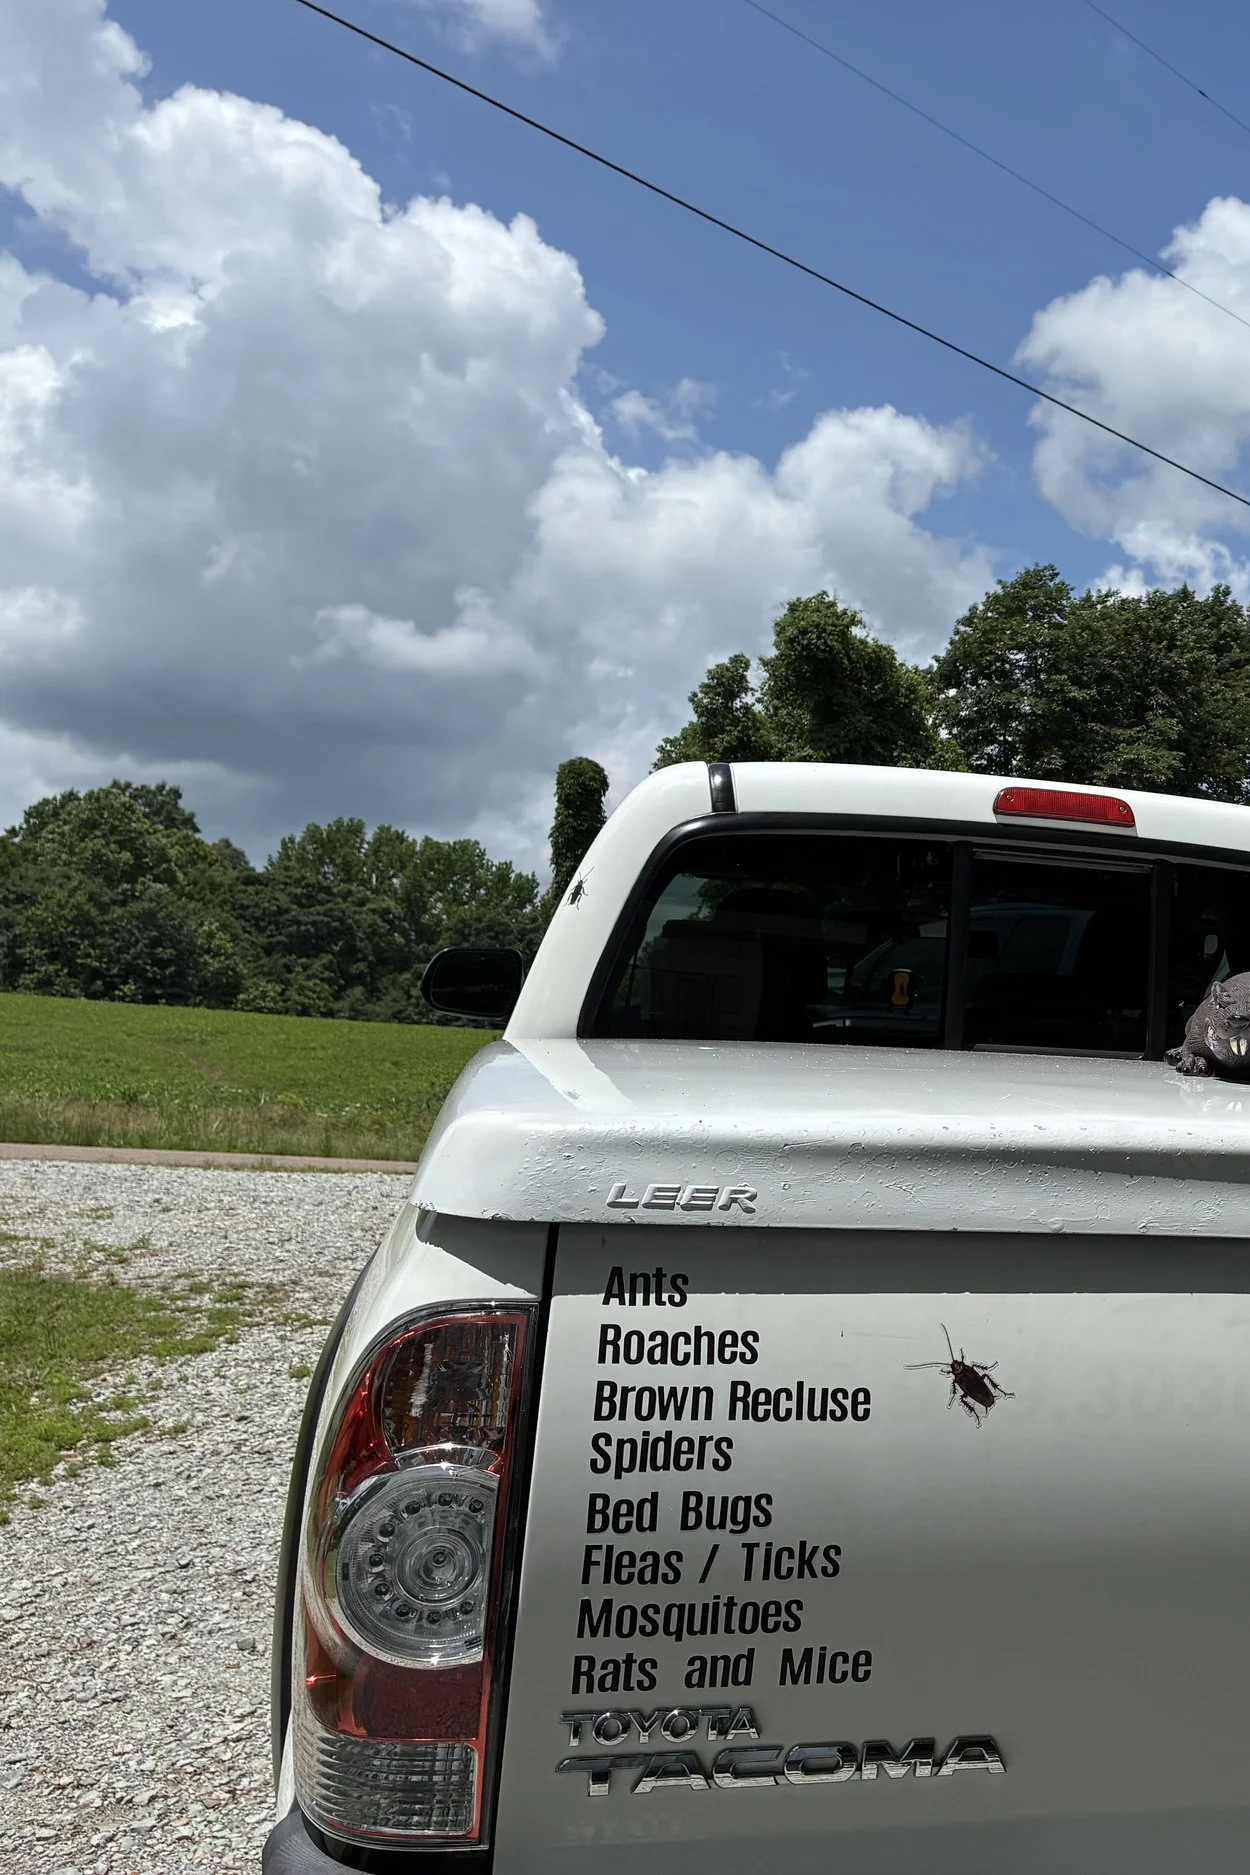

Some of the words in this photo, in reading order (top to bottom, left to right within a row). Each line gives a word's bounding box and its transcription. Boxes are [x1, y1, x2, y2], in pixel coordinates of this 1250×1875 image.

[605, 1182, 758, 1214] LEER
[602, 1265, 690, 1308] Ants
[597, 1323, 760, 1367] Roaches
[593, 1380, 714, 1422] Brown
[728, 1380, 871, 1423] Recluse
[589, 1430, 734, 1480] Spiders
[586, 1491, 659, 1534] Bed
[679, 1490, 773, 1535] Bugs
[581, 1544, 684, 1586] Fleas
[698, 1543, 720, 1584] /
[741, 1539, 842, 1582] Ticks
[576, 1594, 804, 1643] Mosquitoes
[571, 1652, 658, 1695] Rats
[684, 1647, 756, 1689] and
[778, 1646, 873, 1686] Mice
[560, 1706, 761, 1747] TOYOTA
[555, 1735, 1007, 1797] TACOMA
